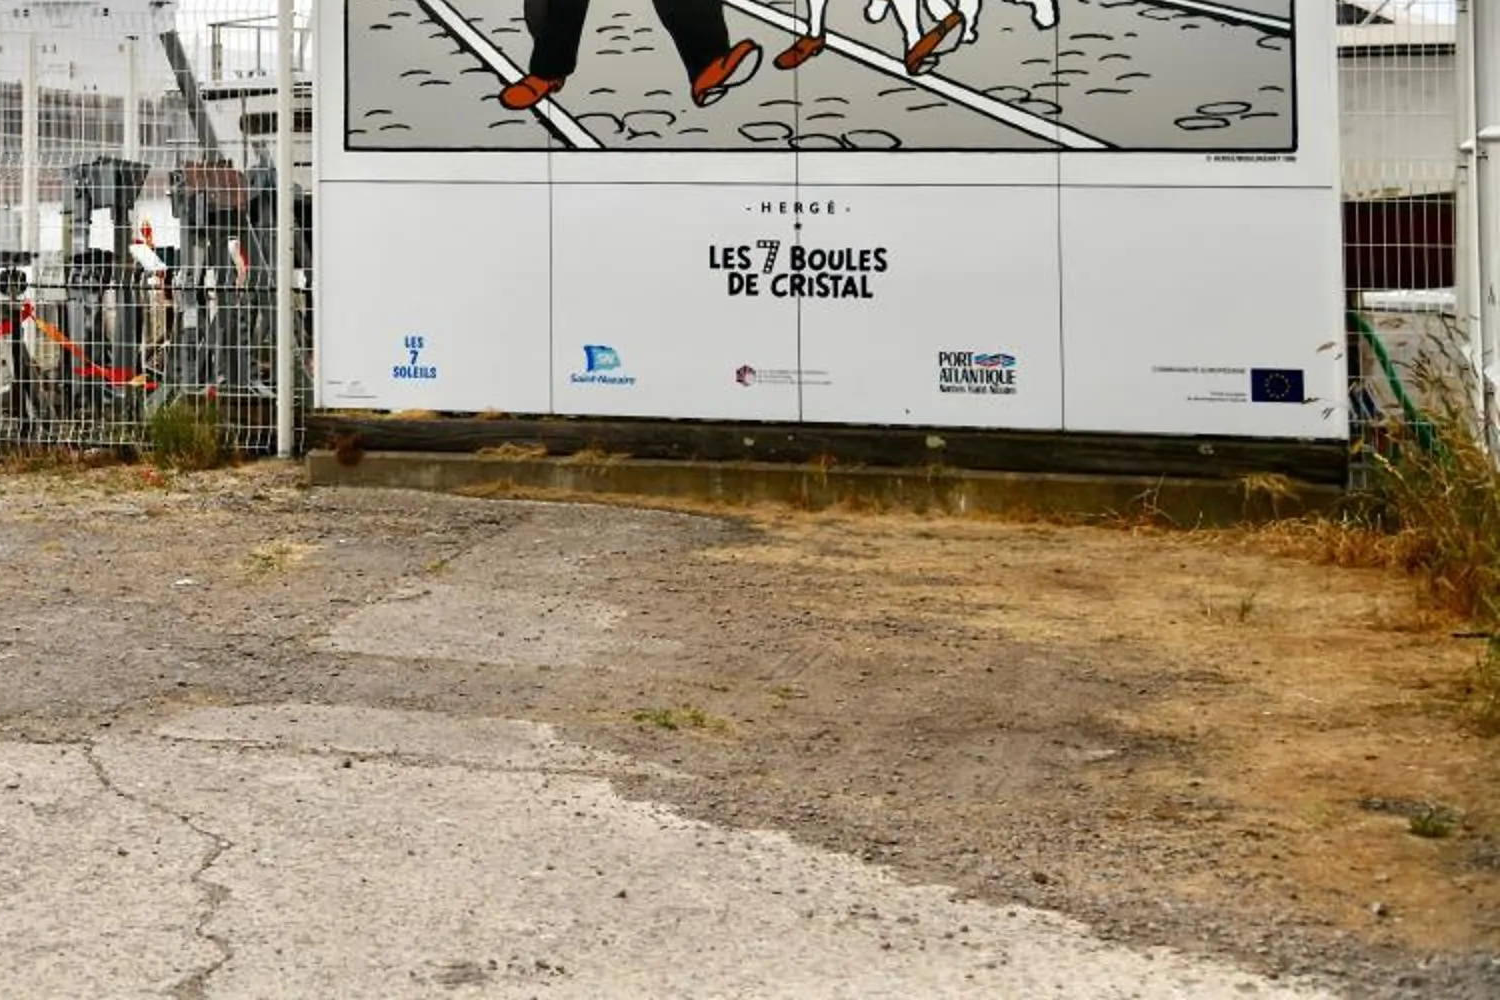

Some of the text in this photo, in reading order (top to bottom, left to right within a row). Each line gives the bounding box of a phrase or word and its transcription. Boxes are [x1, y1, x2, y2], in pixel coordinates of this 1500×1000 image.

[760, 200, 836, 215] HERGÉ
[709, 239, 888, 274] LES 7 BOULES
[728, 272, 874, 299] DE CRISTAL
[404, 335, 425, 349] LES
[409, 349, 419, 365] 7
[939, 351, 973, 367] PORT
[393, 365, 437, 379] SOLEILS
[939, 367, 1017, 386] ATLANTIQUE
